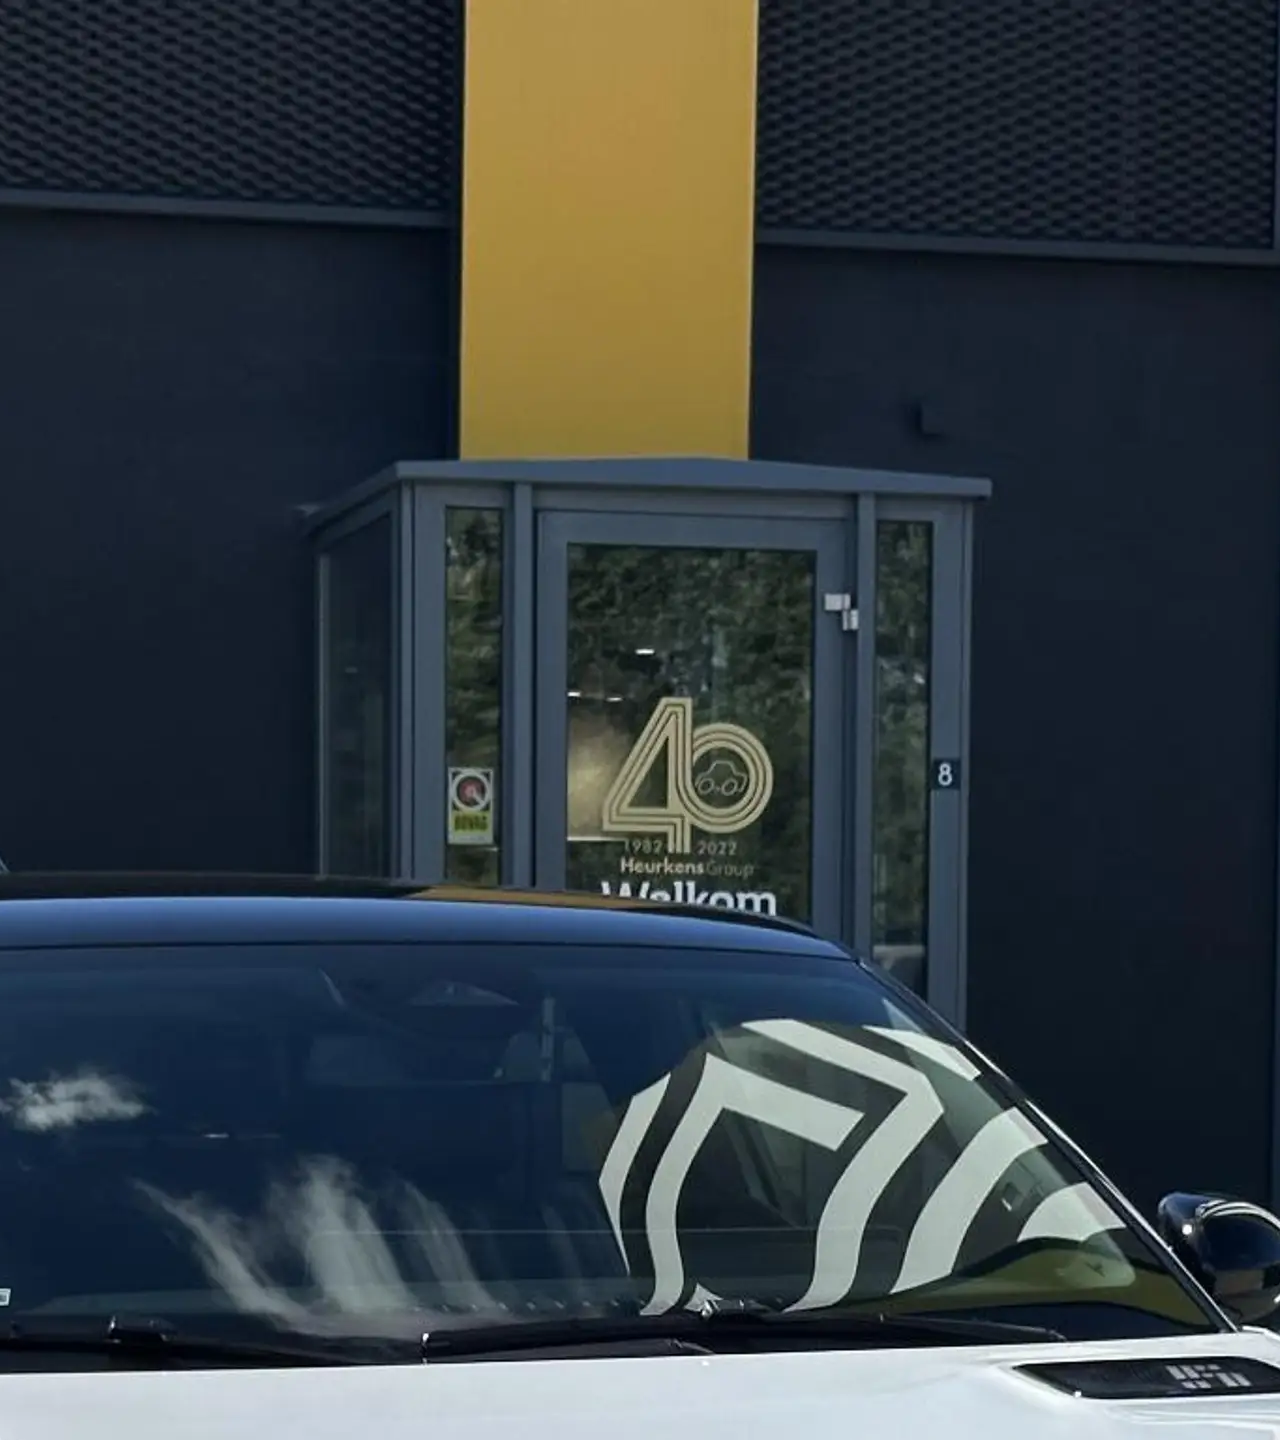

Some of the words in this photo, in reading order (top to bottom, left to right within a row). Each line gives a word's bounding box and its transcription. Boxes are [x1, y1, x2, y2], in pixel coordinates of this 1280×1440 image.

[603, 697, 773, 853] 40
[938, 763, 953, 786] 8
[697, 840, 738, 855] 2022
